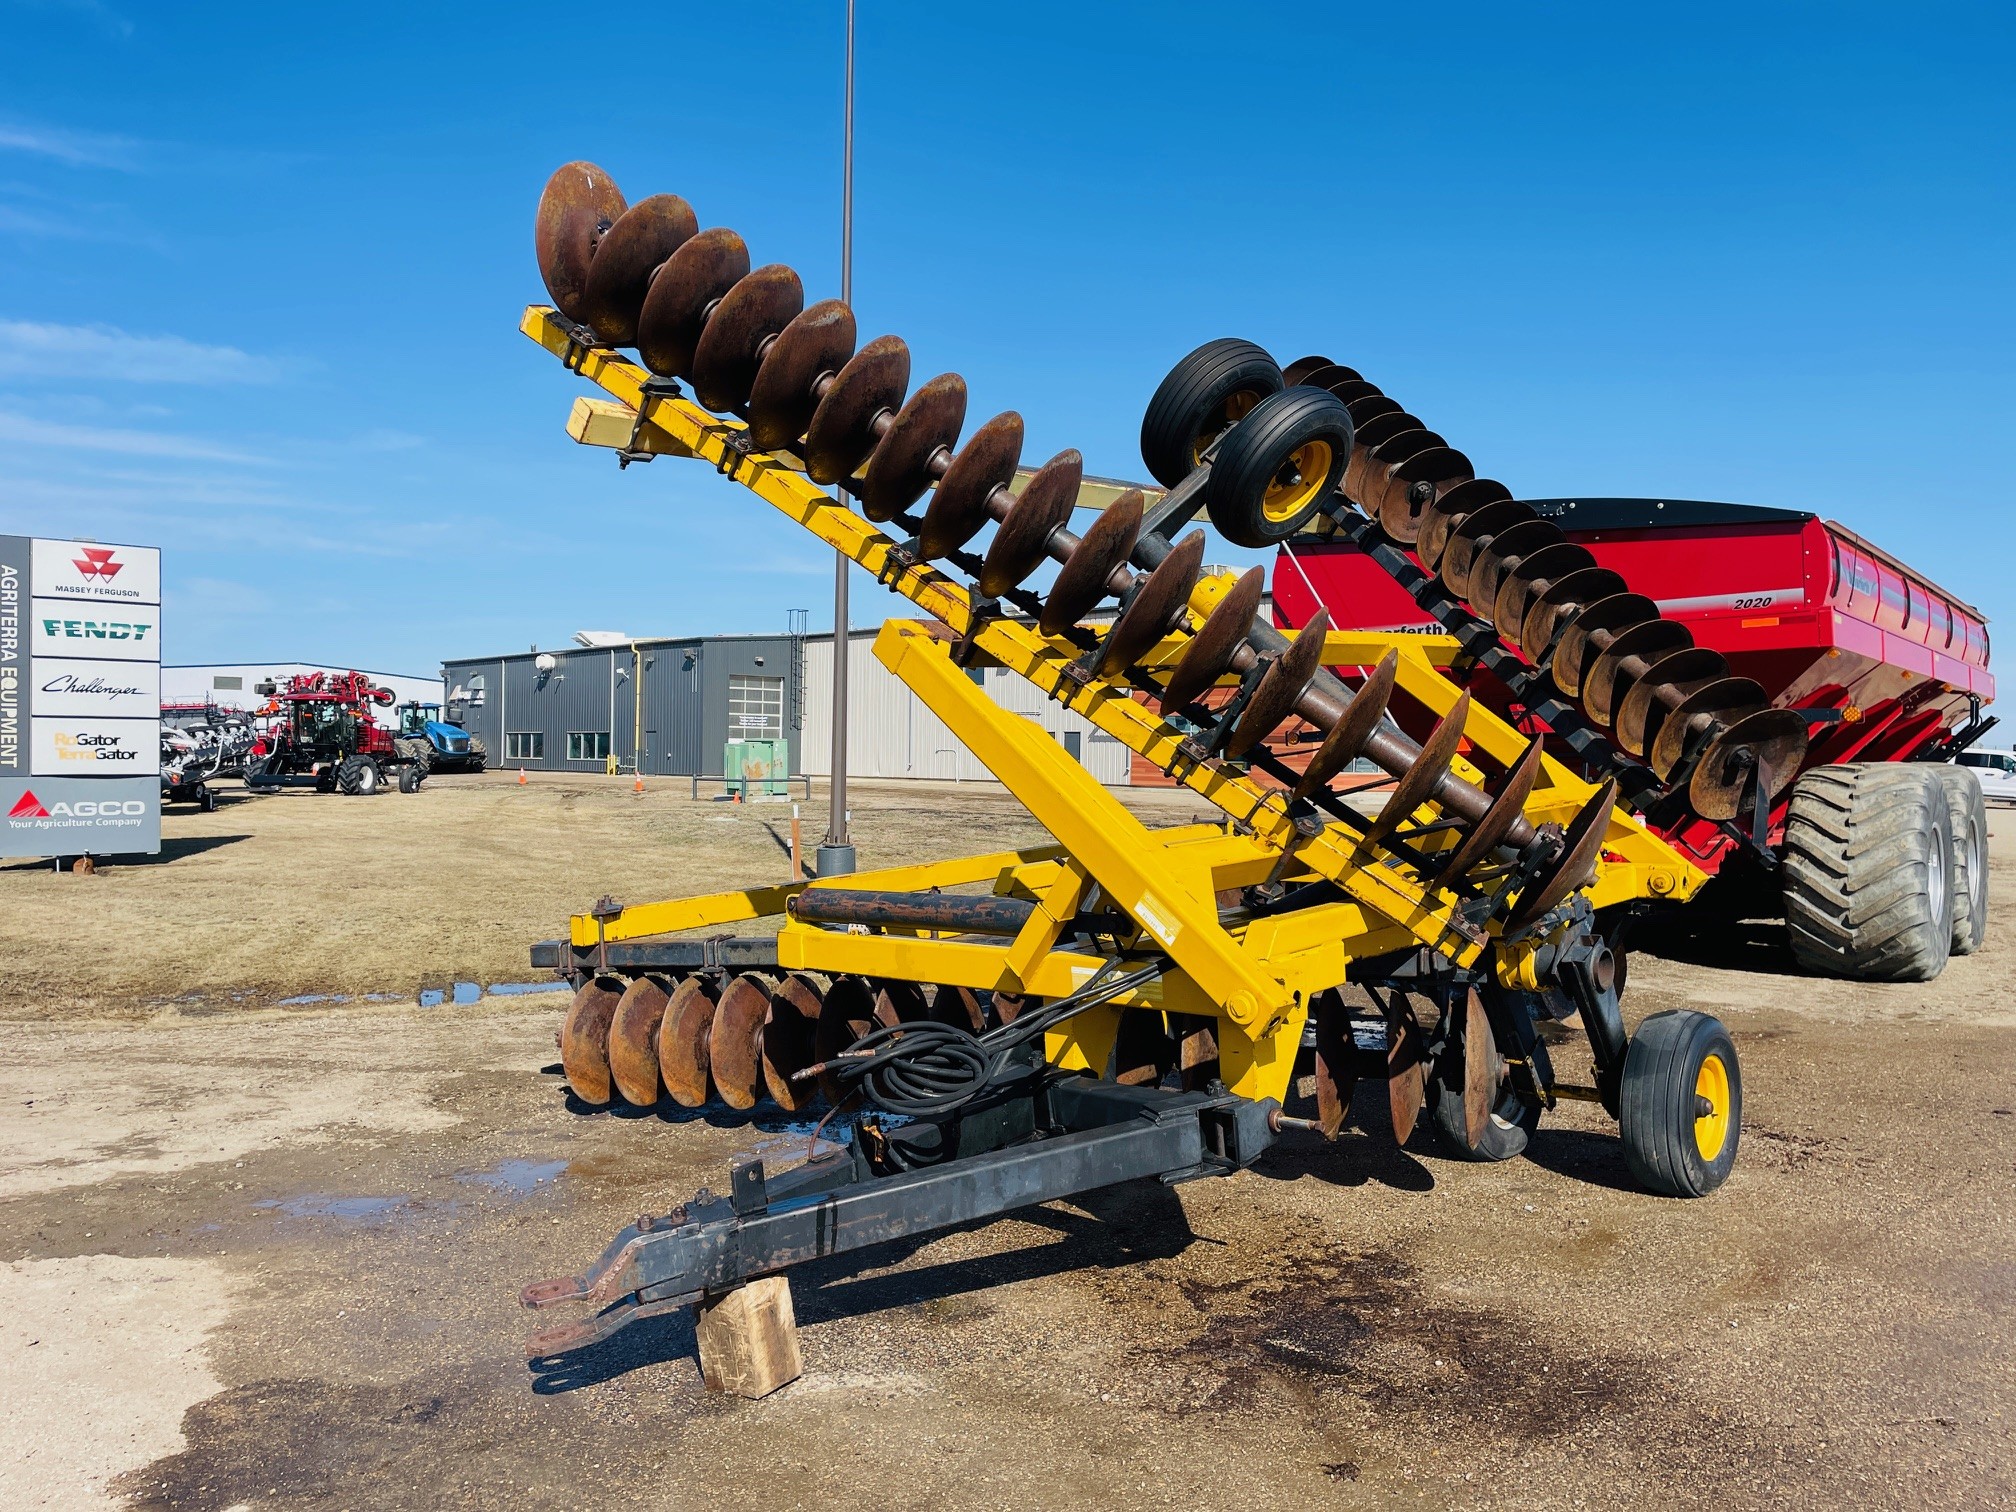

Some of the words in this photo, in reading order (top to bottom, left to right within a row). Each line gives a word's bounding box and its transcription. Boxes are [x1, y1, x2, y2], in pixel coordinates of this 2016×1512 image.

[55, 585, 91, 594] MASSEY
[94, 588, 140, 597] FERGUSON
[1733, 597, 1772, 610] 2020
[0, 564, 18, 662] AGRITERRA
[42, 619, 152, 641] FENDT
[41, 674, 151, 701] Challenger
[0, 667, 18, 768] EQUIPMENT
[54, 732, 121, 746] RoGator
[57, 747, 139, 760] TerraGator
[50, 800, 146, 817] AGCO
[9, 820, 33, 829] Your
[34, 818, 93, 830] Agriculture
[95, 817, 143, 827] Company
